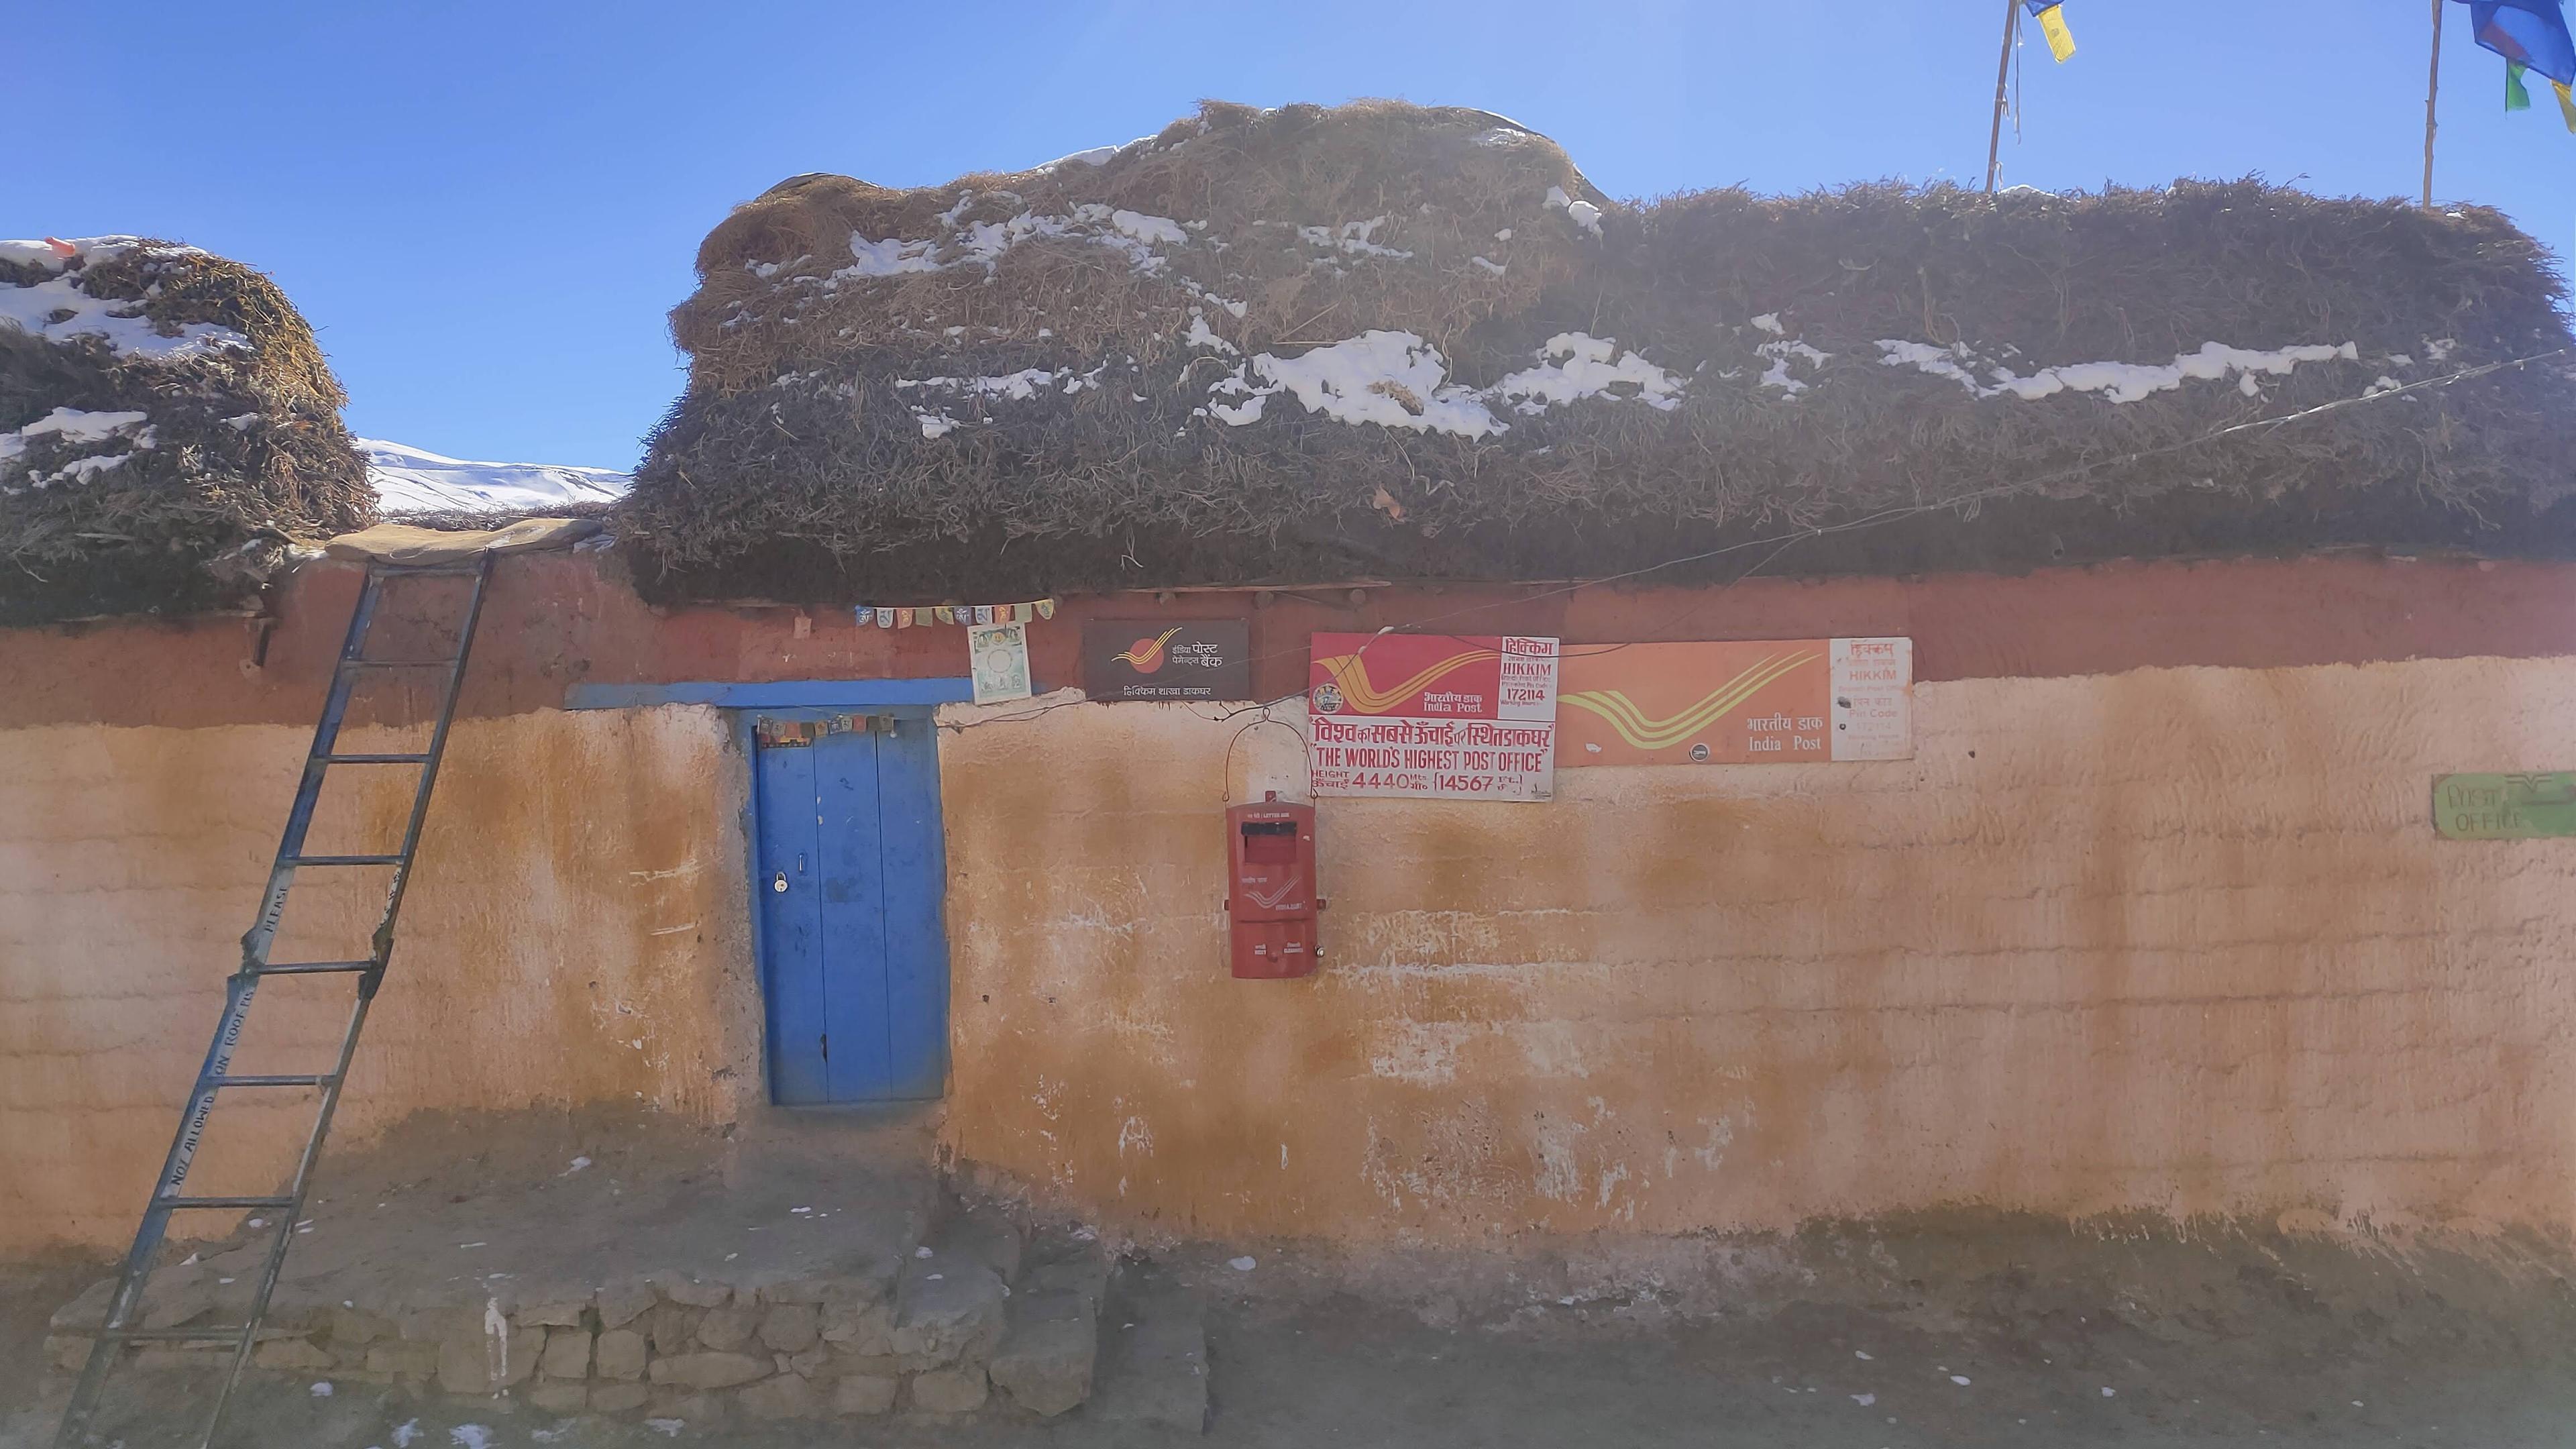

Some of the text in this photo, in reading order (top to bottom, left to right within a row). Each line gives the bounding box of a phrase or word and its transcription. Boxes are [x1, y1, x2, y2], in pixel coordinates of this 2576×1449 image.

[1172, 641, 1218, 654] इंडिया पोस्ट
[1200, 654, 1223, 667] बैंक
[1503, 663, 1552, 676] HIKKIM
[1849, 669, 1897, 680] HIKKIM
[1159, 688, 1181, 696] शाखा
[1183, 688, 1212, 696] डाकघर
[1424, 691, 1483, 703] भारतीय डाक
[1507, 688, 1546, 701] 172114
[1424, 702, 1483, 712] India Post
[1870, 708, 1898, 718] Code
[1747, 712, 1824, 731] भारतीय डाक
[1371, 720, 1414, 744] सबसे
[1750, 735, 1821, 751] India Post
[1345, 746, 1400, 768] WORLD'S
[1404, 749, 1459, 770] HIGHEST
[1464, 751, 1495, 771] POST
[1311, 770, 1350, 778] HEIGHT
[1352, 771, 1409, 790] 4440
[171, 1161, 189, 1185] NOT
[184, 1096, 215, 1152] ALLOWED
[214, 1055, 229, 1075] ON
